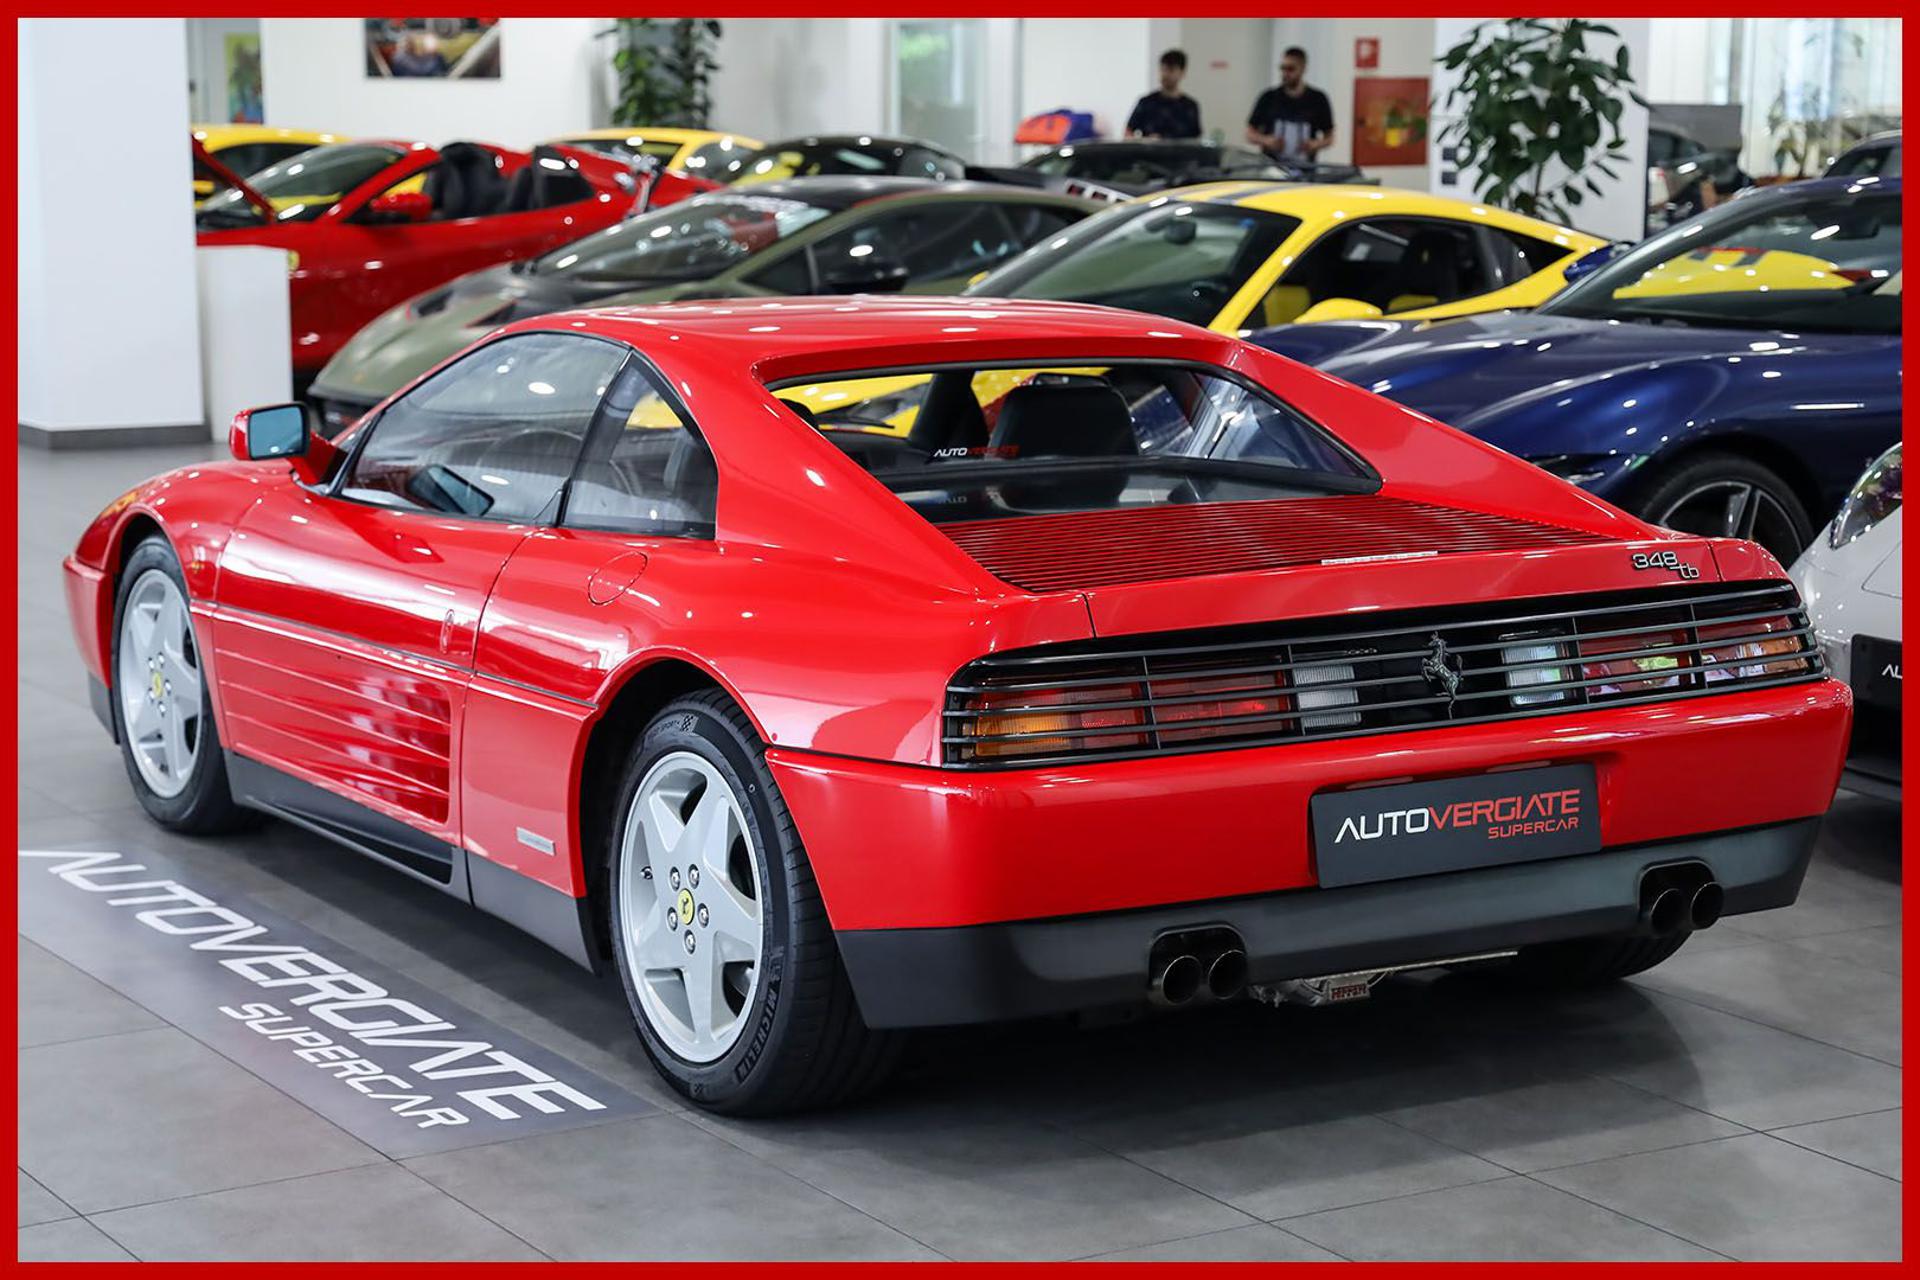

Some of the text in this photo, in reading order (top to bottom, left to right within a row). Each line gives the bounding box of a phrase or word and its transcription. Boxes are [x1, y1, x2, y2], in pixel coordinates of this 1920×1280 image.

[1632, 551, 1700, 579] 348 tb
[1334, 789, 1580, 843] AUTOVERGIATE
[1488, 816, 1579, 840] SUPERCAR
[18, 850, 607, 1120] AUTOVERGIATE
[218, 1003, 470, 1128] SUPERCAR
[737, 985, 779, 1081] MICHELIN
